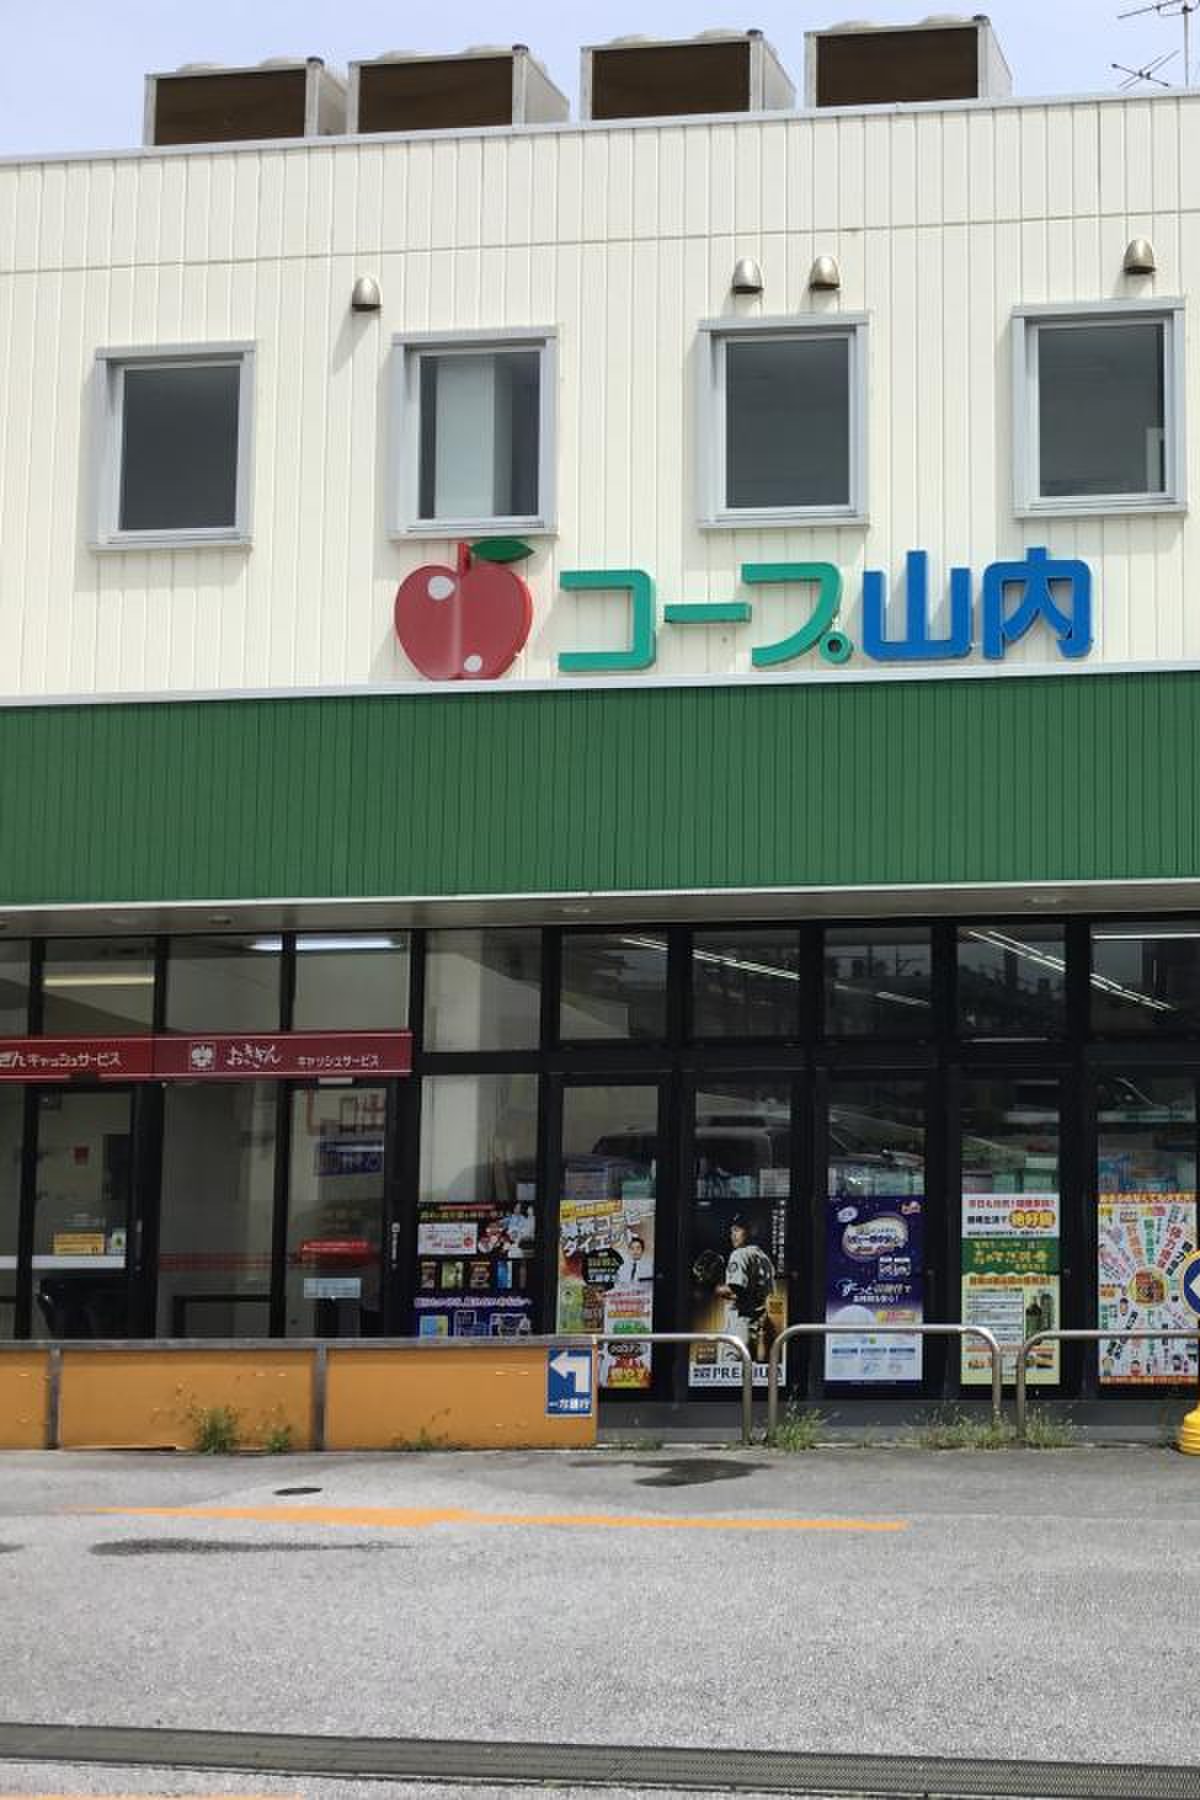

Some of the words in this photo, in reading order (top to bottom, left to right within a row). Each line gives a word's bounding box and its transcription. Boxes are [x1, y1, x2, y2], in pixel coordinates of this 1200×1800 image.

[557, 546, 1093, 672] コープ山内
